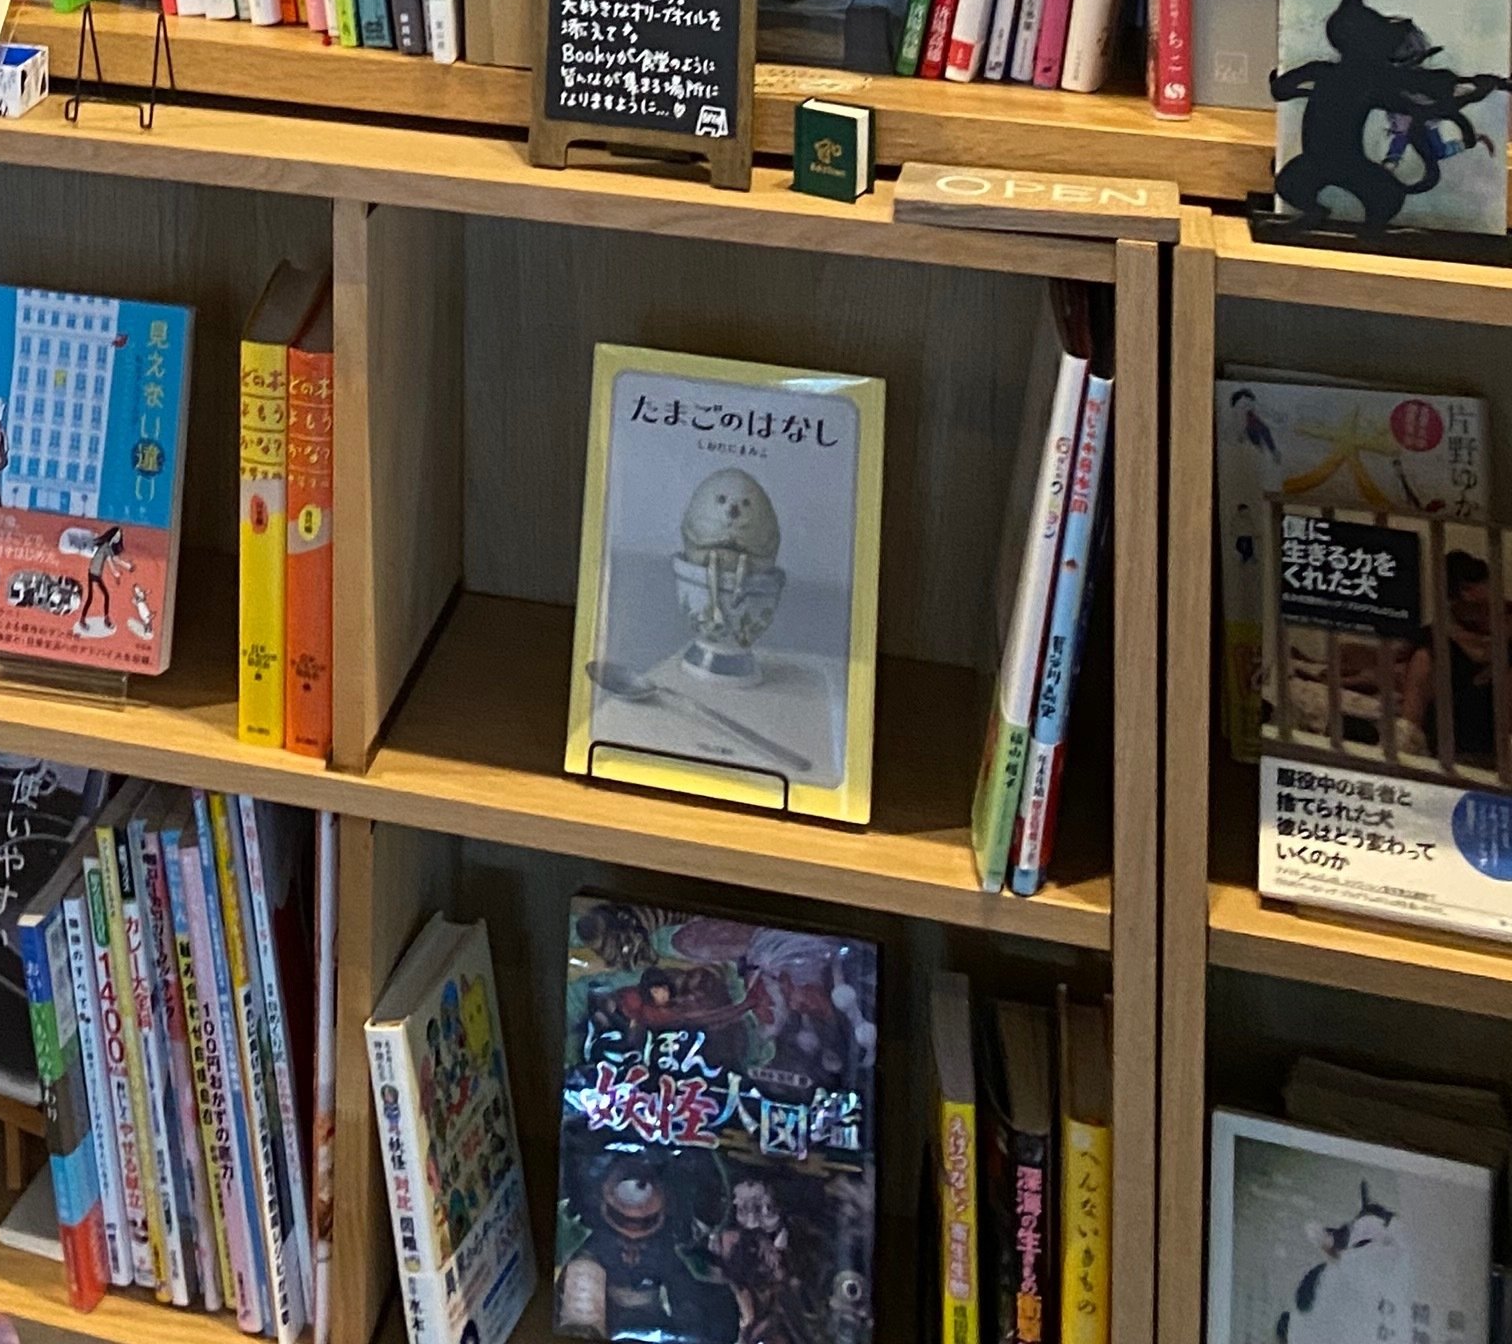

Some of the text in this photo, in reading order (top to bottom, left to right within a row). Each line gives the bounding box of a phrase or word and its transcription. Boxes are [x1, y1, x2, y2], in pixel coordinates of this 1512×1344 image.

[935, 174, 1149, 207] OPEN
[133, 319, 170, 505] 見えない違い
[630, 393, 840, 449] たまごのはなし
[1281, 543, 1397, 579] 生きる力を
[1281, 568, 1379, 602] くれた犬
[1276, 768, 1413, 808] 服役中の若者と
[1276, 791, 1395, 831] 捨てられた犬
[1275, 843, 1352, 871] いくのか
[1276, 816, 1438, 862] 彼らはどう変わって
[98, 952, 126, 1065] 1400
[583, 1020, 723, 1079] にっぽん
